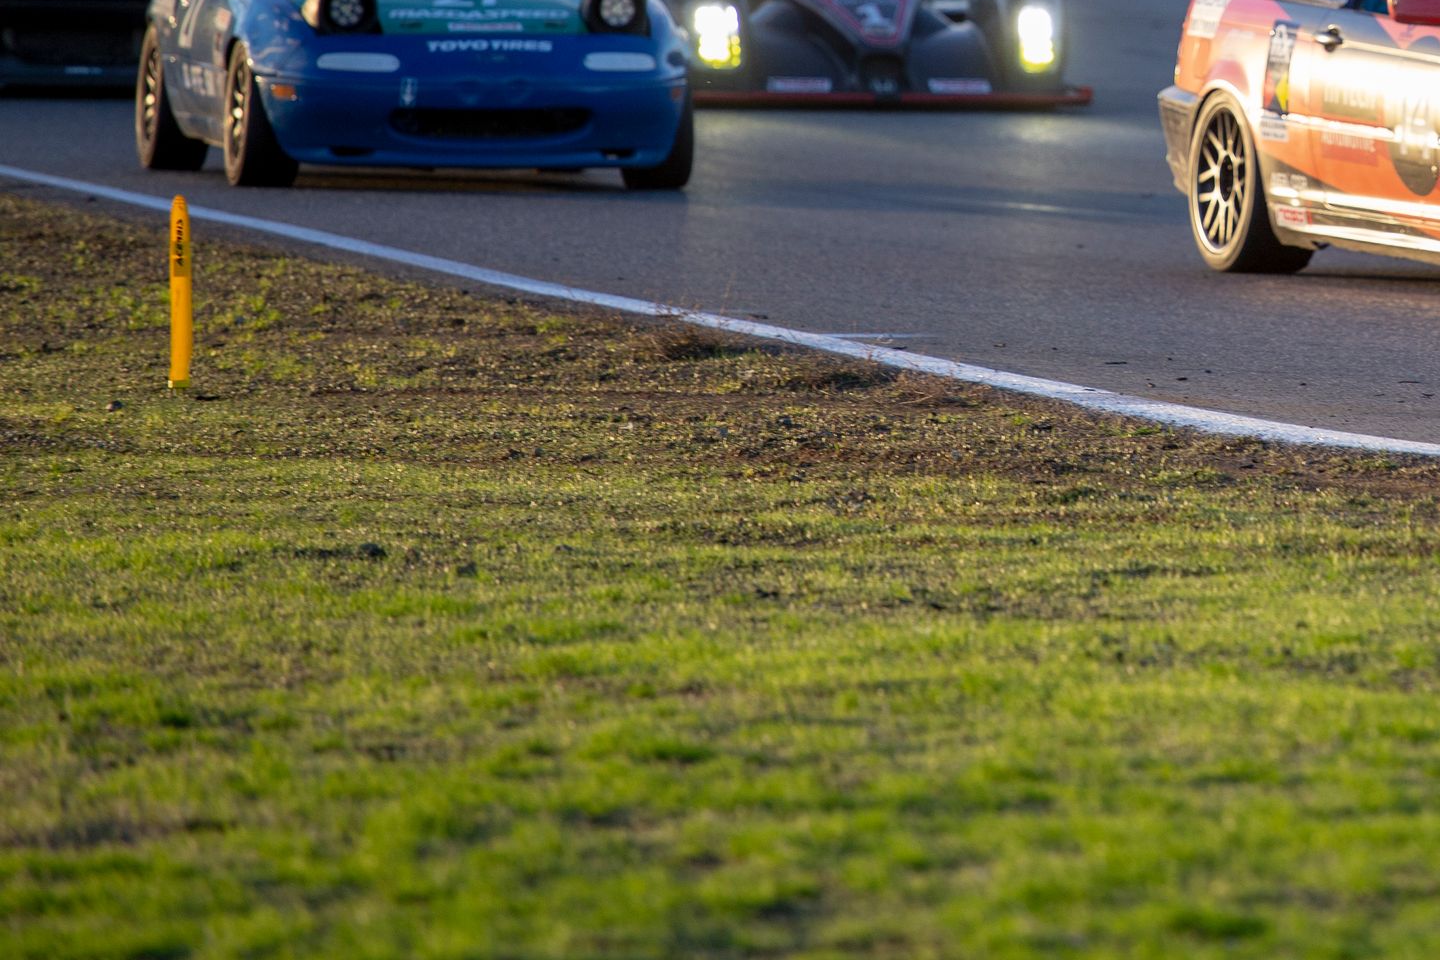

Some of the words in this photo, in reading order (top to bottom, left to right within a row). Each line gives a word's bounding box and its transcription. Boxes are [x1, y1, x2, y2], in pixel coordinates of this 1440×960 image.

[387, 8, 570, 20] MAZDASPEED
[427, 40, 488, 53] TOYO
[491, 40, 552, 53] TIRES
